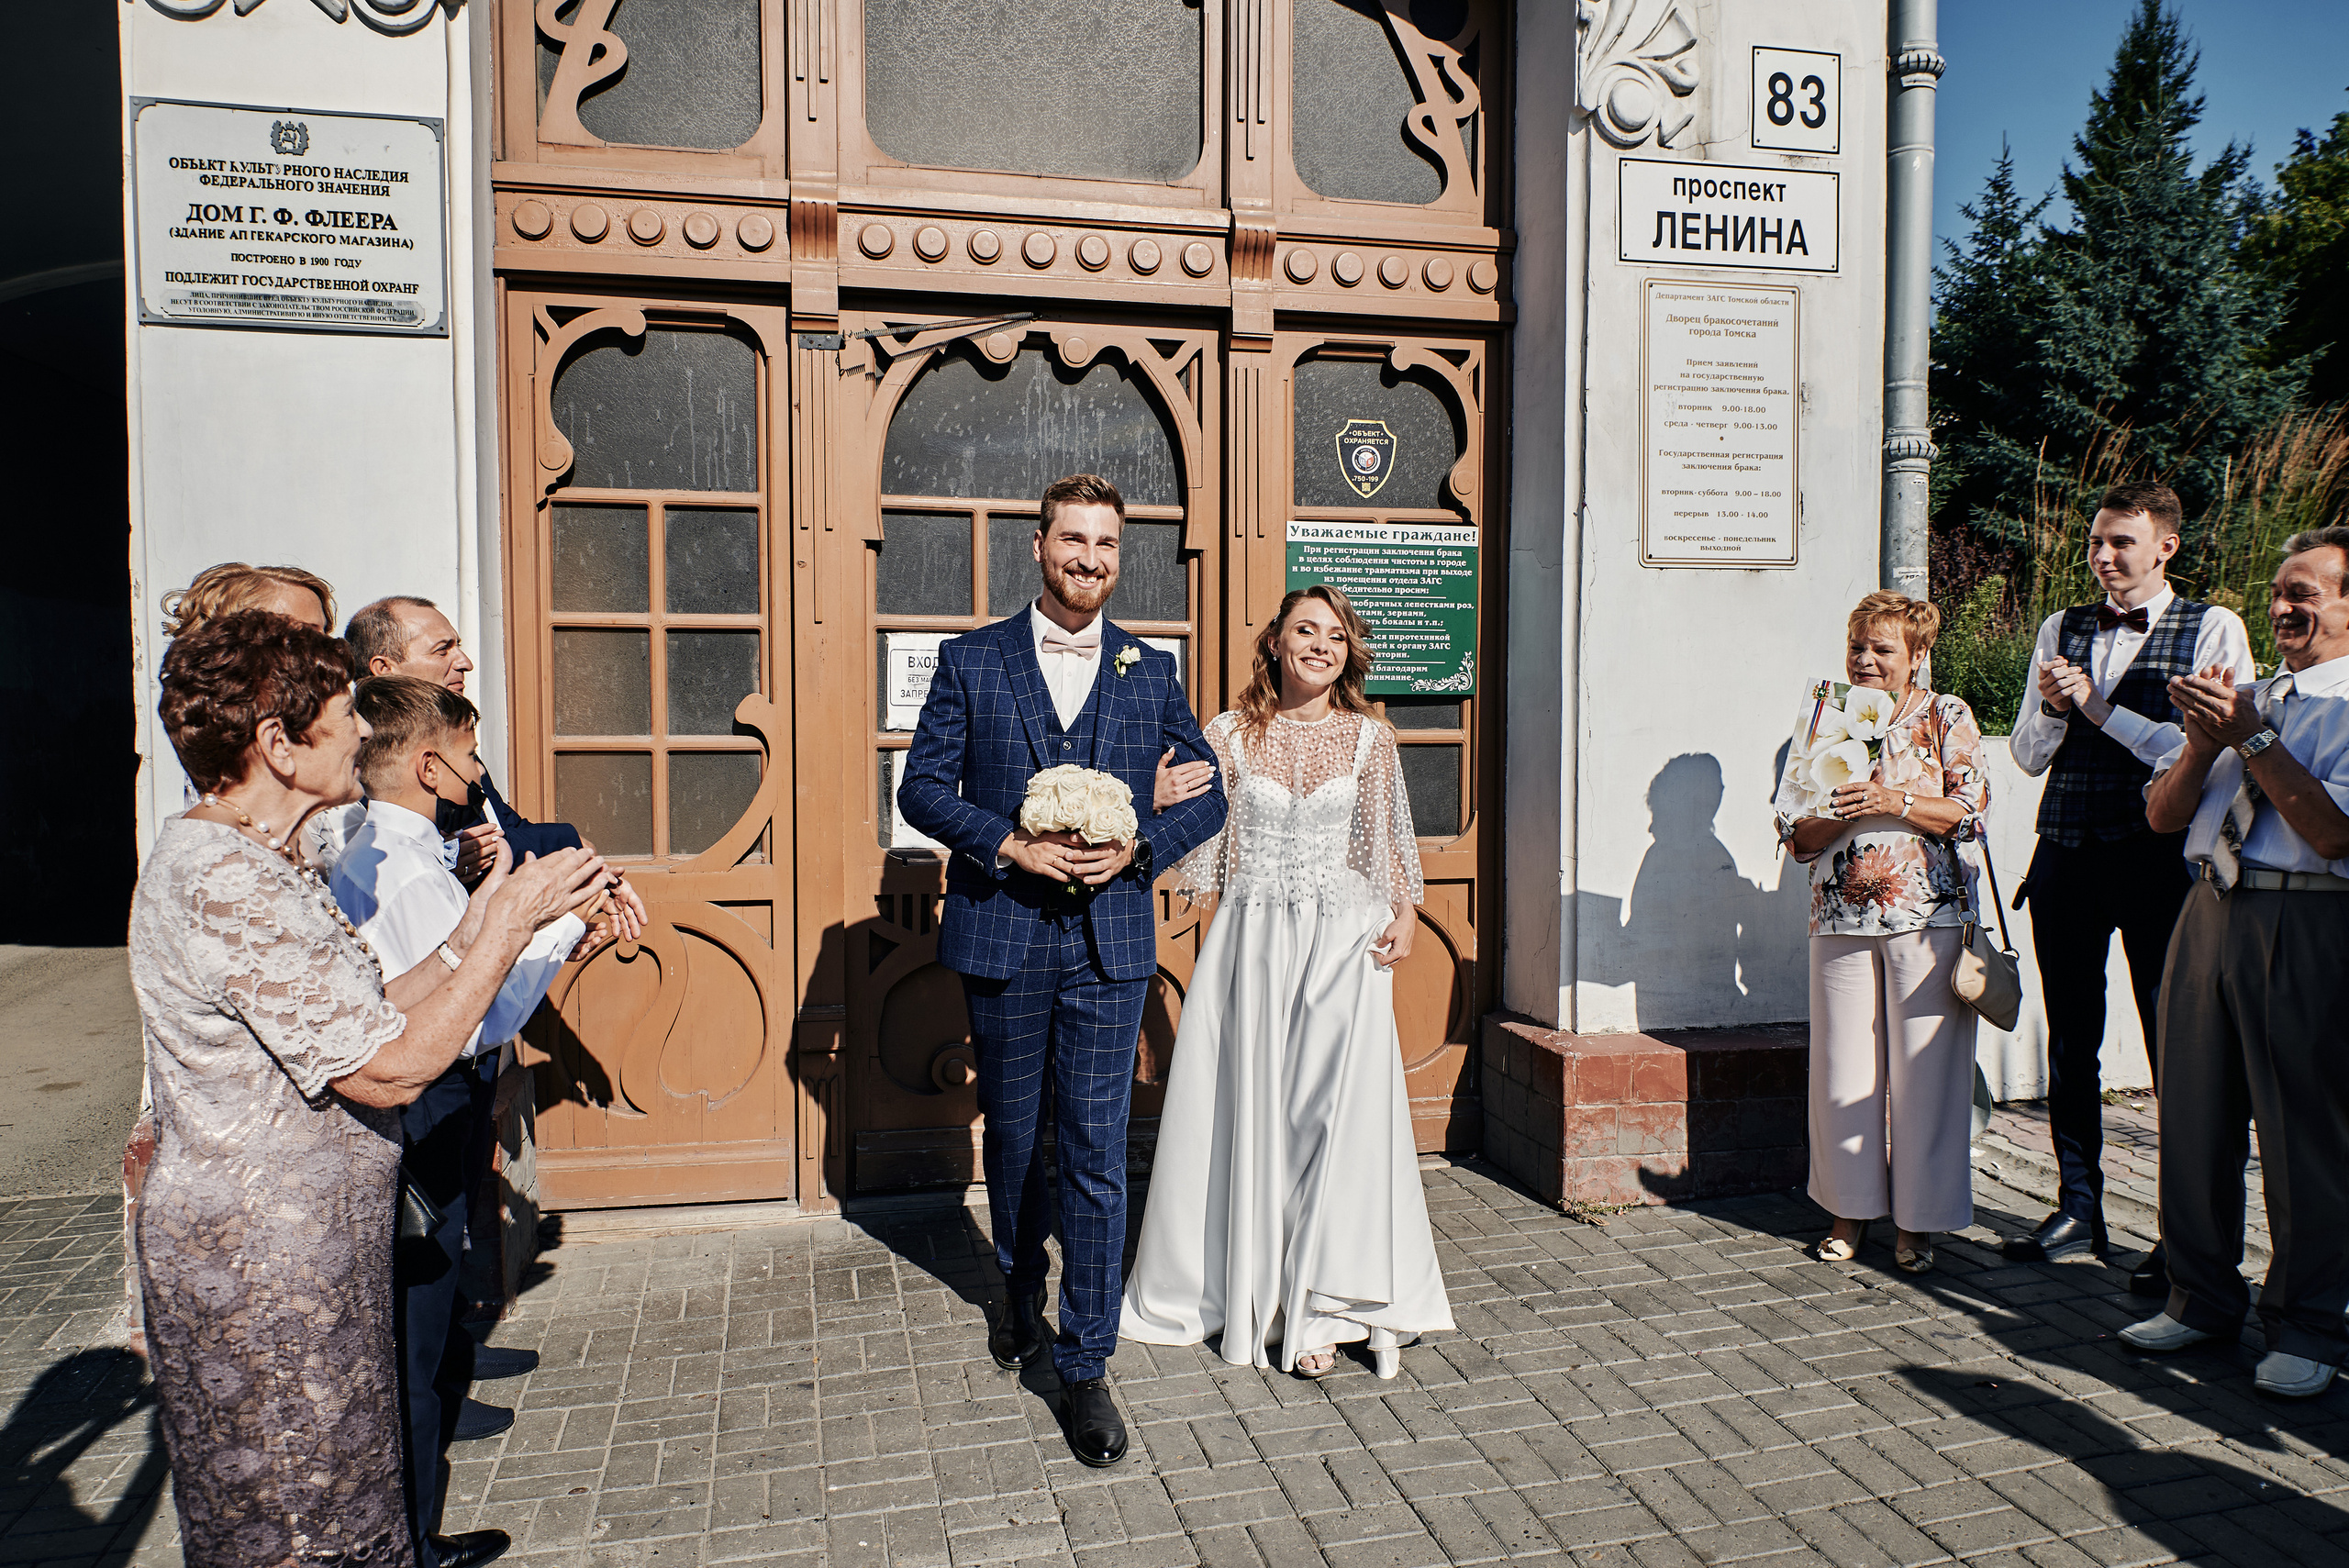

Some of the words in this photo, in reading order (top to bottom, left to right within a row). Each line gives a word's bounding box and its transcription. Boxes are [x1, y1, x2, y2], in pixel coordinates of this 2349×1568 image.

[1767, 72, 1826, 128] 83
[169, 157, 226, 172] ОБЪЕКТ
[334, 167, 409, 183] НАСЛЕДИЯ
[199, 174, 314, 193] ФЕДЕРАЛЬНОГО
[317, 181, 390, 197] ЗНАЧЕНИЯ
[1673, 177, 1787, 204] проспект
[186, 203, 244, 224] ДОМ
[250, 206, 267, 224] Г.
[273, 207, 299, 226] Ф.
[305, 209, 398, 231] ФЛЕЕРА
[169, 227, 225, 240] (ЗДАНИЕ
[229, 230, 336, 245] АПТЕКАРСКОГО
[340, 234, 414, 250] МАГАЗИНА)
[1652, 211, 1809, 256] ЛЕНИНА
[231, 252, 295, 266] ПОСТРОЕНО
[300, 256, 306, 266] В
[310, 256, 329, 267] 1900
[334, 258, 362, 269] ГОДУ
[165, 271, 239, 286] ПОДЛЕЖИТ
[242, 274, 370, 293] ГОСУДАРСТВЕННОЙ
[312, 297, 358, 306] КУЛЬТУРНОГО
[1655, 292, 1704, 301] Департамент
[1707, 294, 1726, 303] ЗАГС
[1727, 296, 1758, 304] Томской
[1760, 297, 1789, 306] области
[199, 300, 251, 308] СООТВЕТСТВИИ
[259, 302, 330, 312] ЗАКОНОДАТЕЛЬСТВОМ
[332, 305, 375, 314] РОССИЙСКОЙ
[1666, 314, 1701, 324] Дворец
[1703, 315, 1779, 328] бракосочетаний
[1689, 328, 1721, 338] города
[1724, 328, 1757, 338] Томска
[1686, 358, 1713, 367] Прием
[1715, 360, 1758, 368] заявлений
[1692, 373, 1764, 382] государственную
[1653, 384, 1708, 393] регистрацию
[1711, 386, 1761, 394] заключения
[1763, 387, 1790, 396] брака.
[1678, 404, 1712, 412] вторник
[1722, 405, 1766, 413] 9.00-18.00
[1664, 420, 1688, 428] среда
[1696, 421, 1728, 429] четверг
[1659, 449, 1730, 459] Государственная
[1732, 452, 1783, 461] регистрация
[1734, 463, 1761, 472] брака:
[1674, 510, 1709, 518] перерыв
[1290, 525, 1388, 539] Уважаемые
[1393, 530, 1476, 543] граждане!
[1664, 534, 1716, 543] воскресенье
[1304, 545, 1321, 554] При
[1323, 547, 1379, 556] регистрации
[1437, 548, 1462, 558] брака
[1335, 555, 1389, 565] соблюдения
[1313, 564, 1362, 573] избежание
[1382, 617, 1415, 626] бокалы
[1376, 664, 1427, 673] благодарим
[900, 689, 929, 698] ЗАПРЕ
